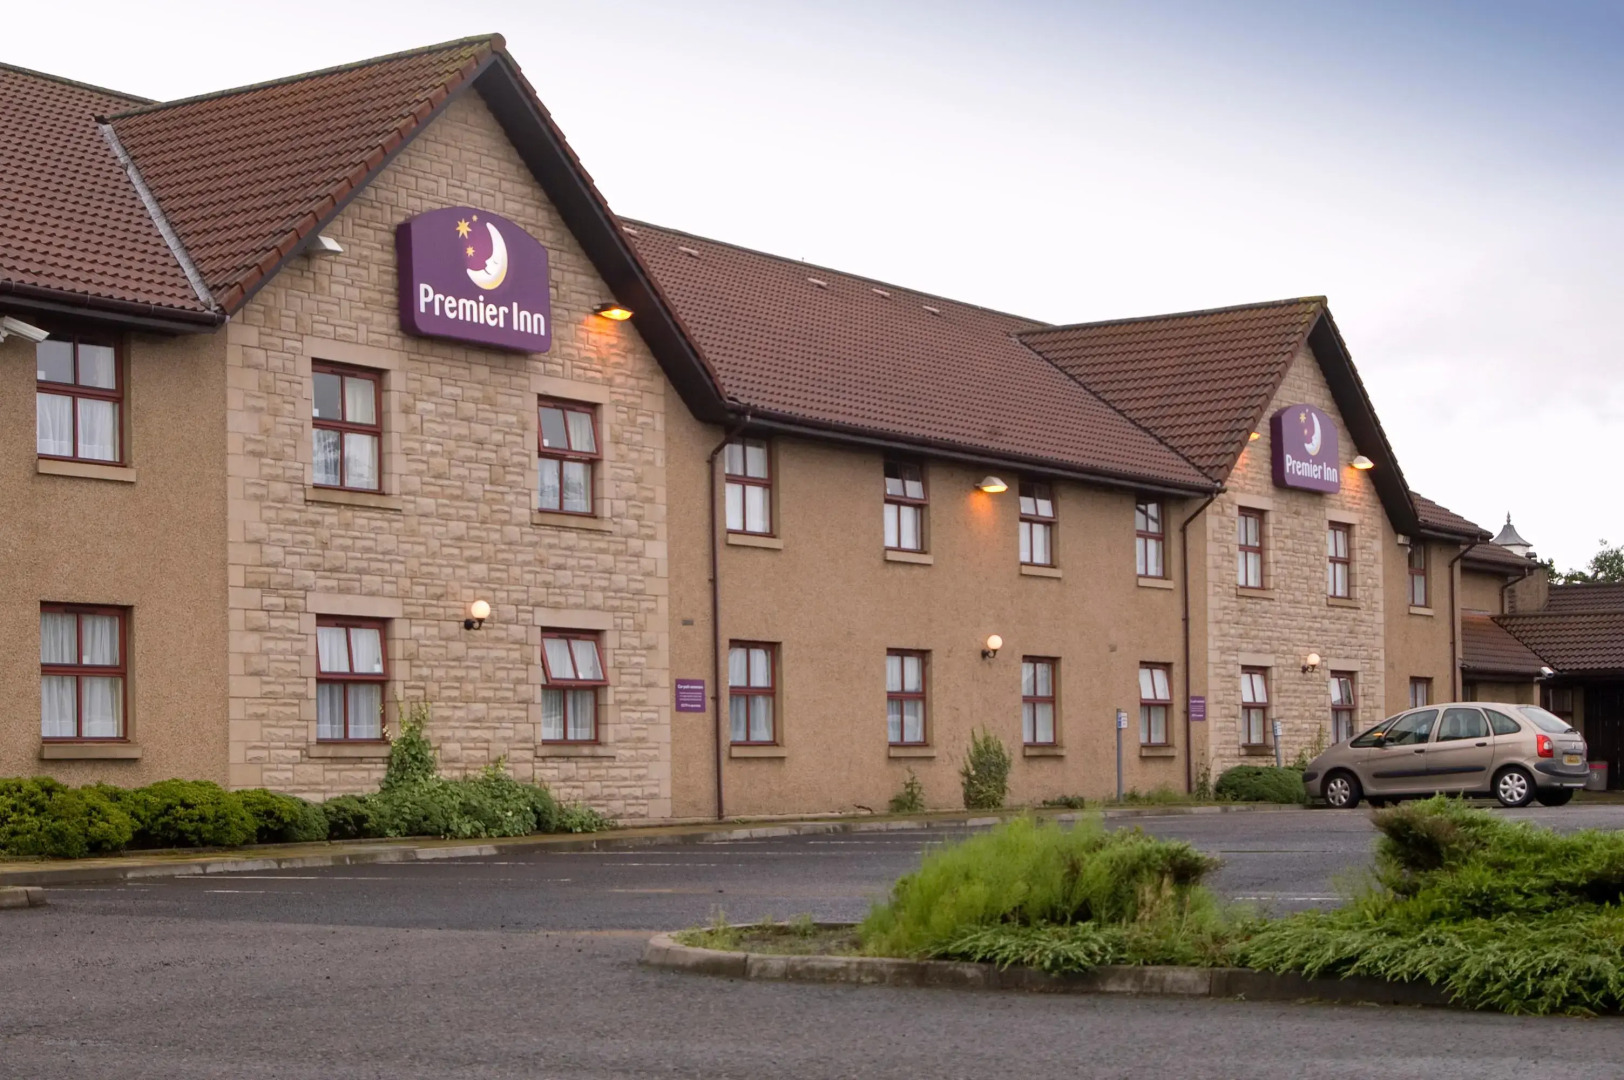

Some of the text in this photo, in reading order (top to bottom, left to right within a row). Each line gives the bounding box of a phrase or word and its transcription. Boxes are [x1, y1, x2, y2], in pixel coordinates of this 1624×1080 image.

[419, 283, 546, 336] Premier Inn
[1285, 454, 1338, 483] Premier Inn
